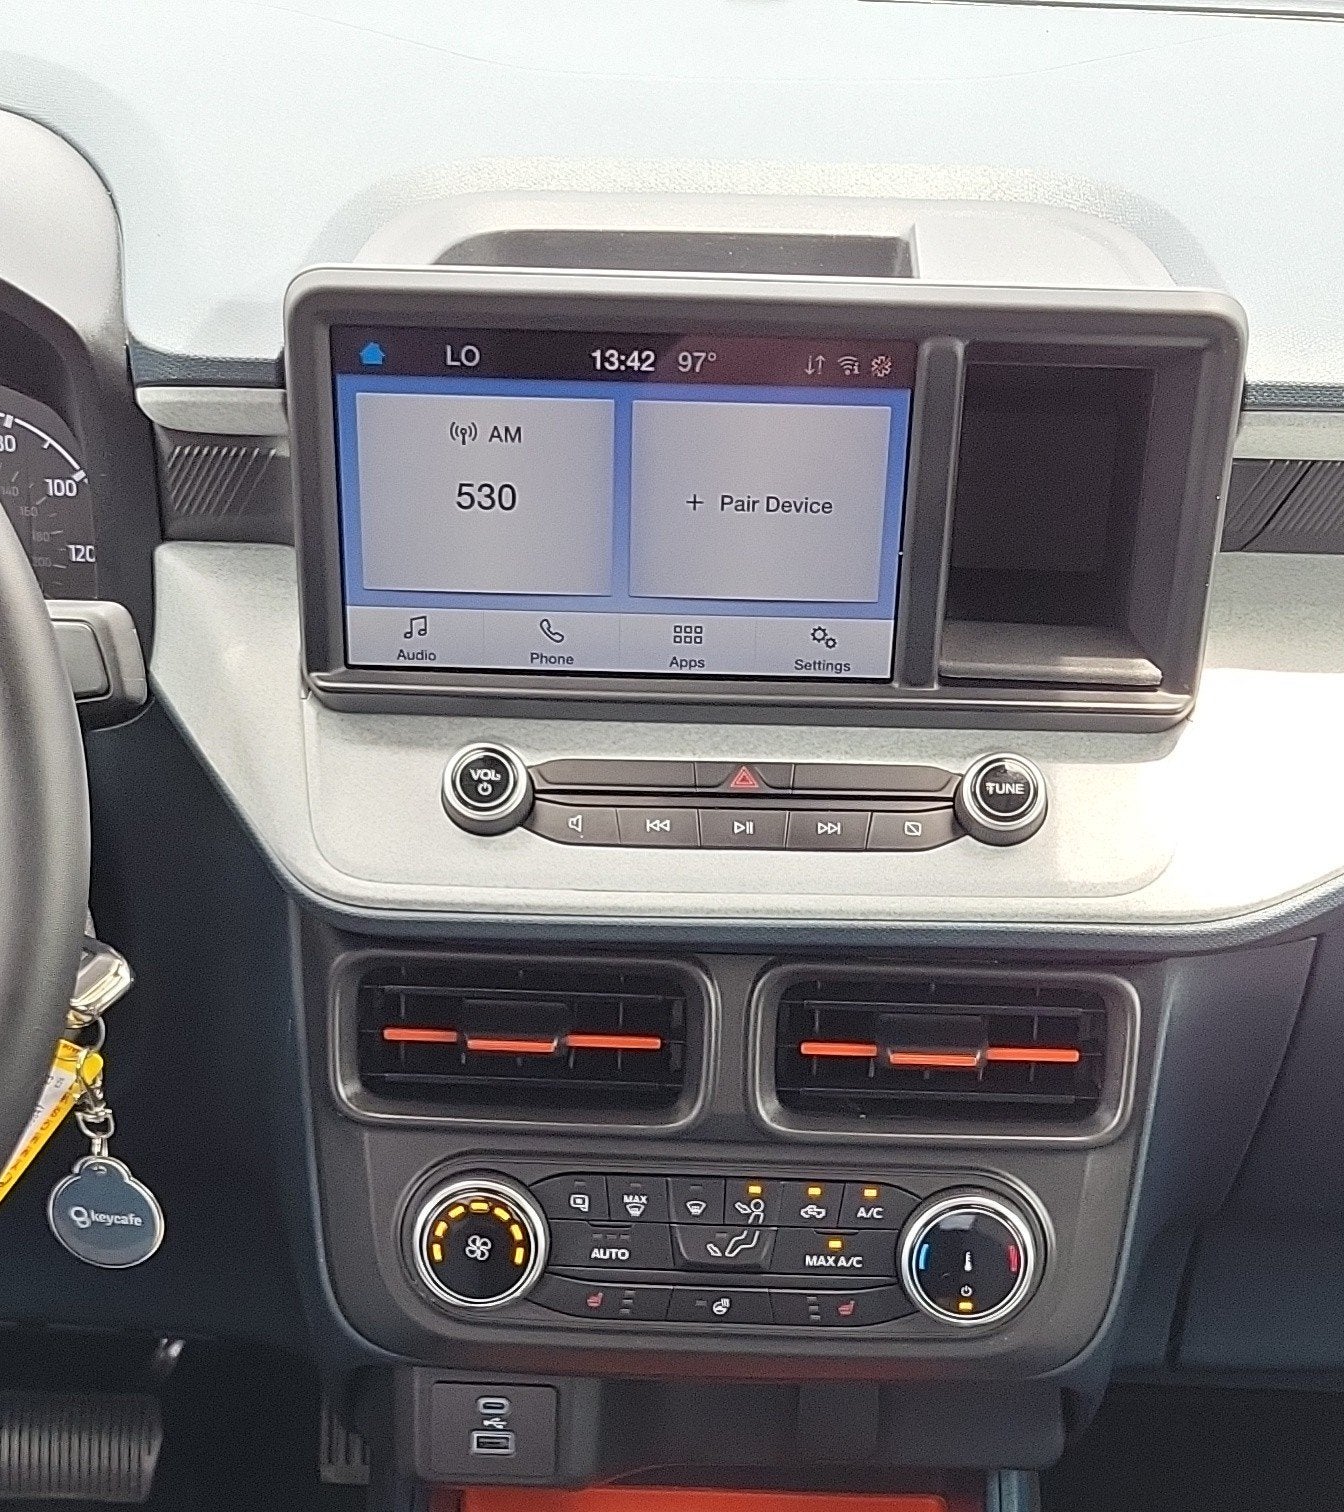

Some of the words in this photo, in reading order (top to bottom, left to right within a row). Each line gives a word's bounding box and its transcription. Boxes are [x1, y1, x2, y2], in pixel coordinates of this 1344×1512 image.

[445, 345, 481, 367] LO
[590, 350, 655, 372] 13:42
[677, 351, 717, 373] 97°
[488, 425, 522, 444] AM
[44, 478, 77, 497] 100
[456, 483, 517, 512] 530
[720, 494, 760, 513] Pair
[765, 496, 833, 515] Device
[67, 544, 96, 562] 120
[397, 648, 437, 663] Audio
[530, 651, 575, 666] Phone
[669, 656, 705, 671] Apps
[794, 659, 851, 674] Settings
[469, 768, 501, 781] VOL
[985, 782, 1025, 795] TUNE
[623, 1194, 648, 1204] MAX
[90, 1209, 143, 1227] keycafe
[856, 1207, 884, 1219] A/C
[590, 1248, 630, 1260] AUTO
[805, 1255, 837, 1267] MAX
[838, 1256, 863, 1268] A/C
